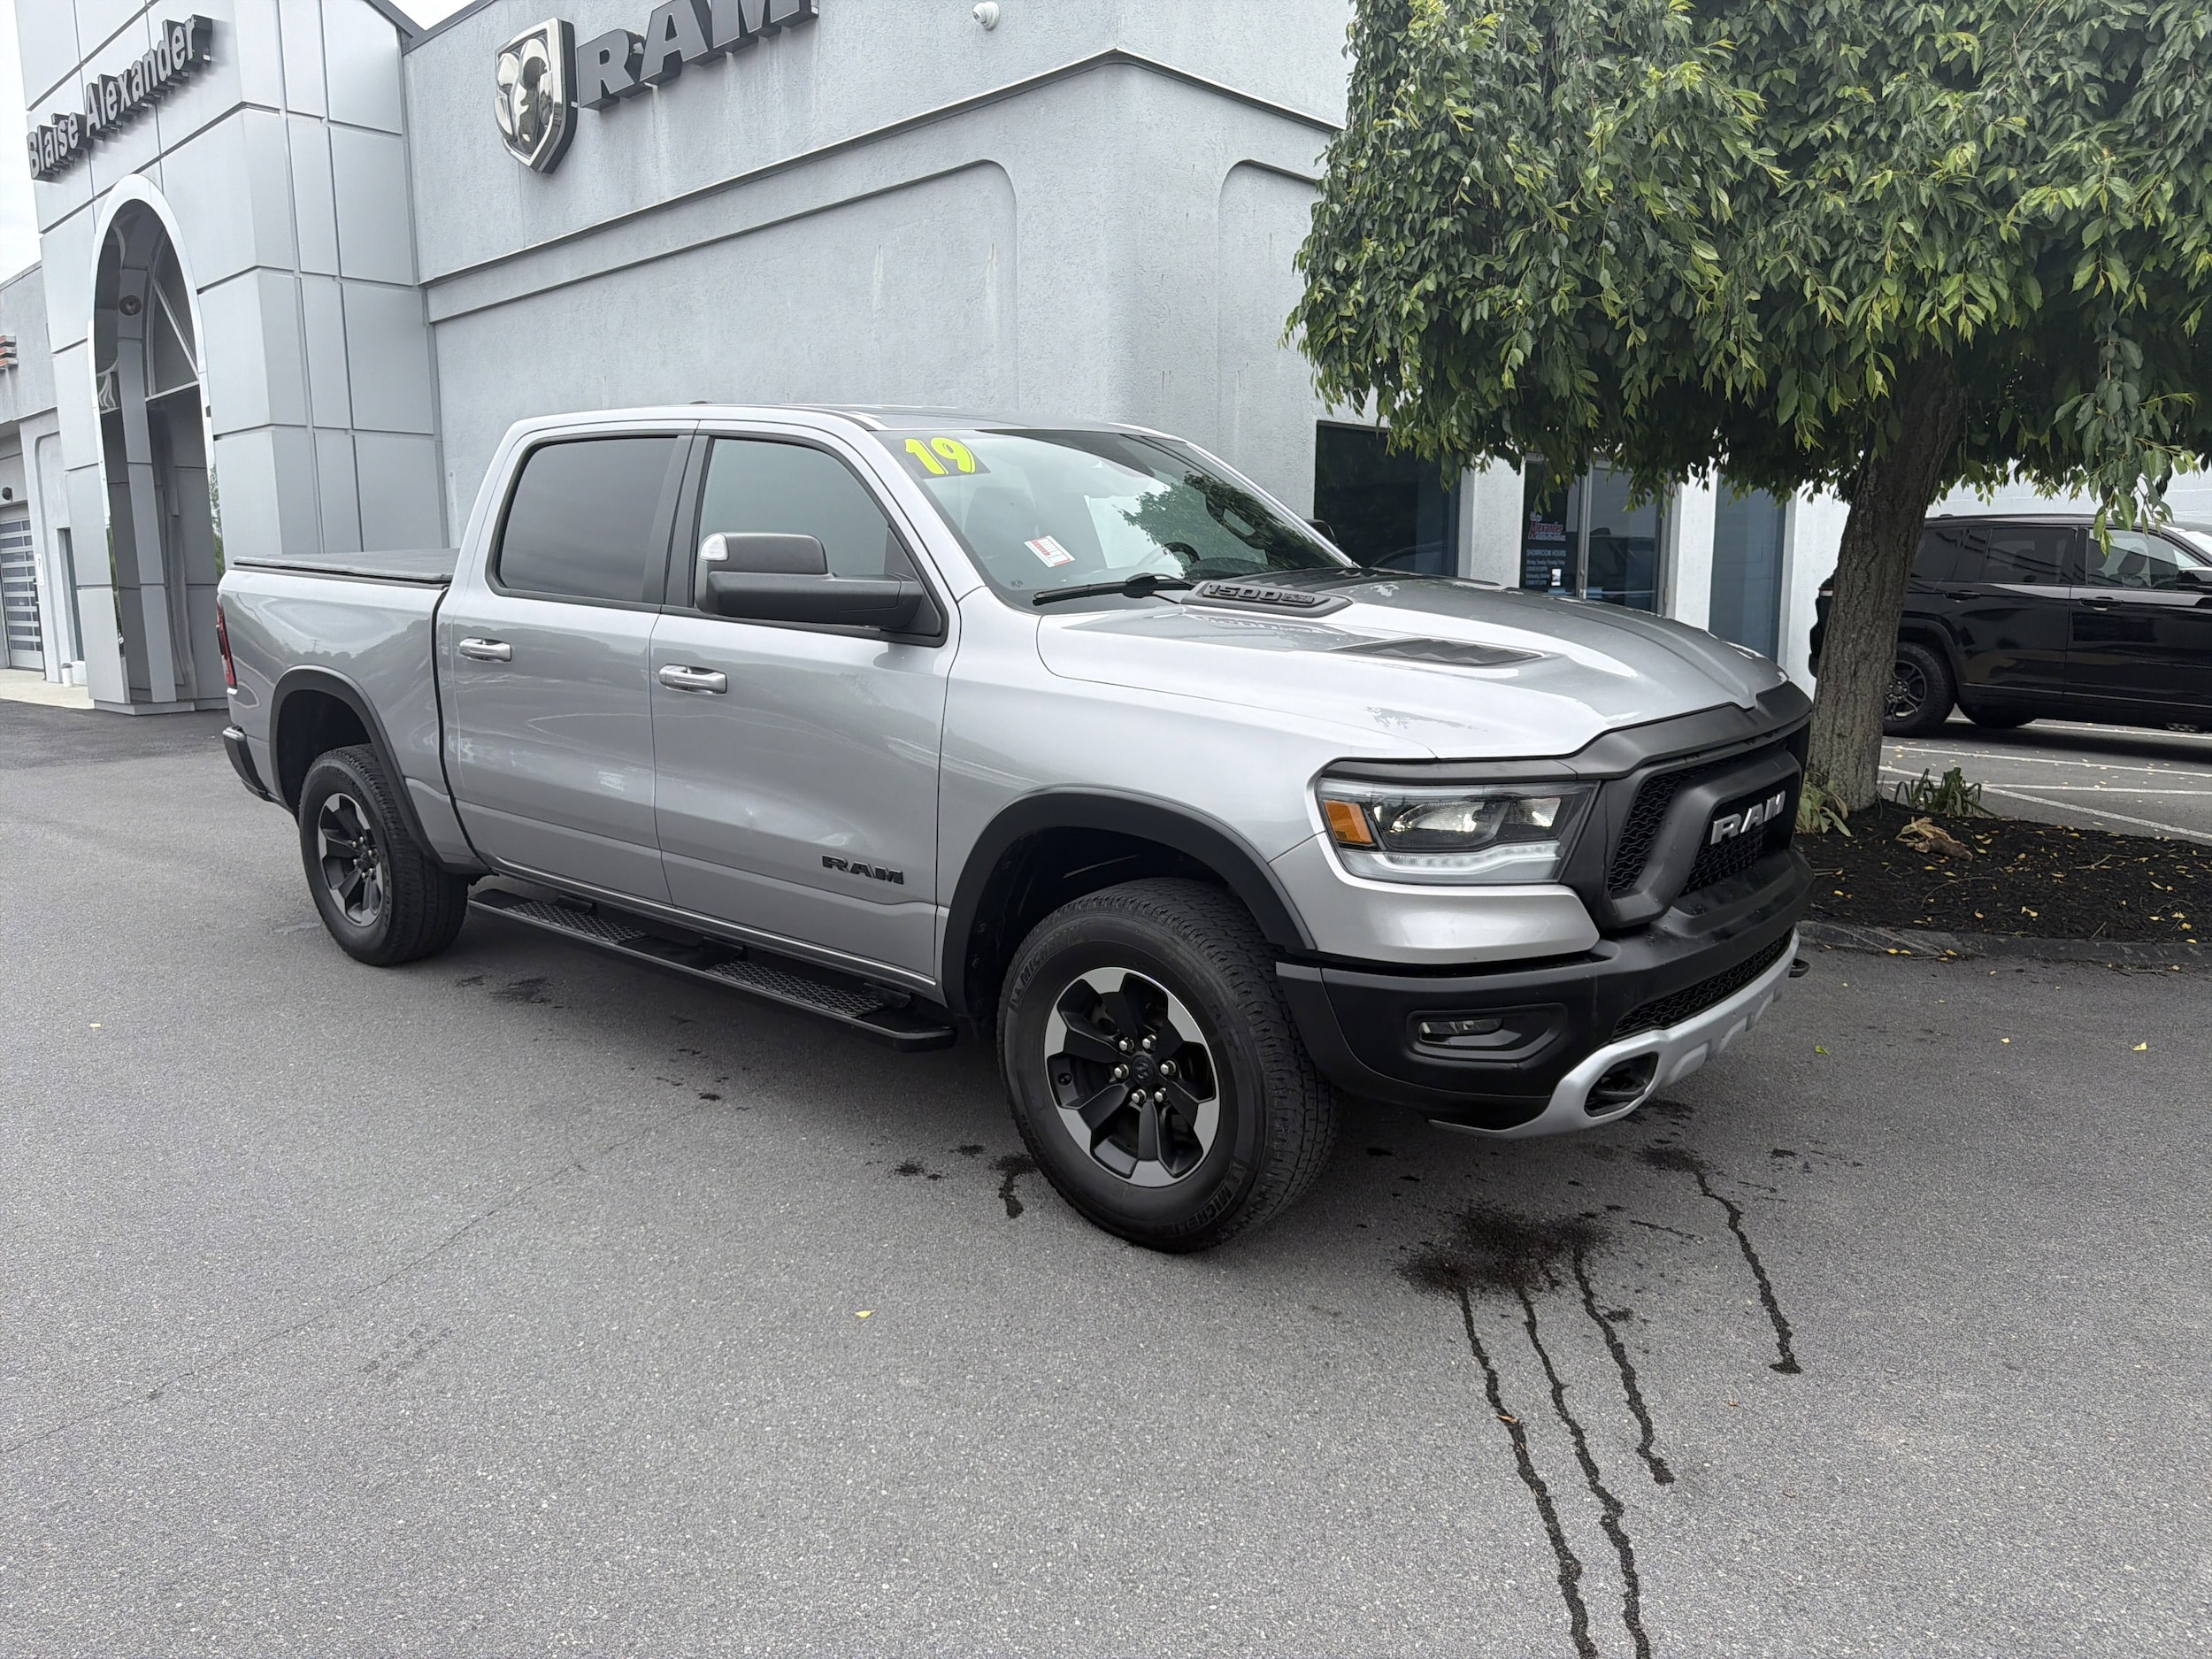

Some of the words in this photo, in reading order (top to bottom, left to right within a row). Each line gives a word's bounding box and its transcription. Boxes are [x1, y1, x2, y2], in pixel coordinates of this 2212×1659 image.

[27, 112, 80, 179] Blaise
[87, 14, 198, 137] Alexander
[905, 437, 977, 475] 19
[1203, 584, 1283, 602] 1500
[1709, 790, 1786, 846] RAM
[822, 854, 904, 885] RAM
